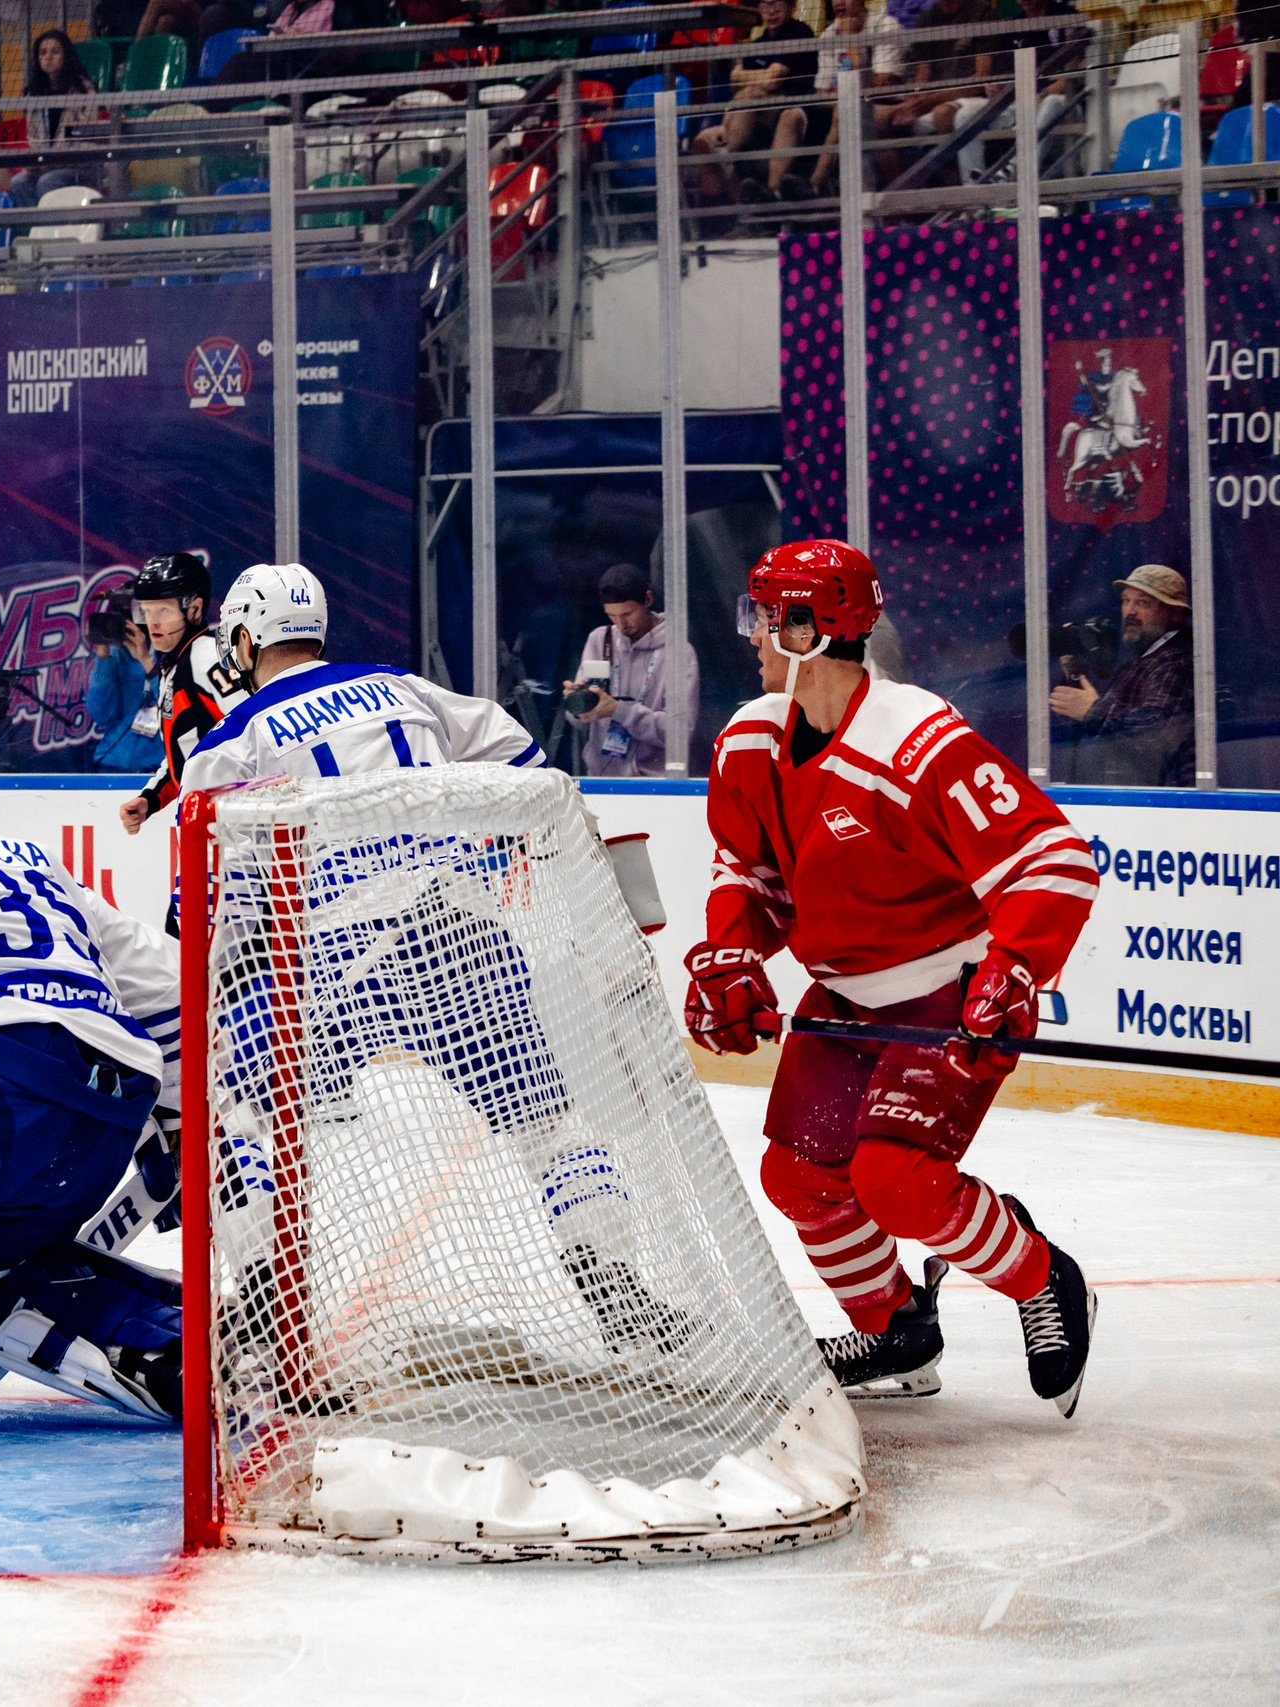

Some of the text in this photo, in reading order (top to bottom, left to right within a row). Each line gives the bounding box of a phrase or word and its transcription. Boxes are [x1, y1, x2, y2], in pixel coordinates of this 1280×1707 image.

[7, 338, 148, 382] МОСКОВСКИЙ
[257, 339, 360, 359] Ферация
[296, 366, 340, 380] ккея
[7, 381, 73, 414] СПОРТ
[296, 391, 344, 406] сквы
[228, 606, 242, 614] CCM
[291, 588, 311, 605] 44
[266, 681, 404, 748] АДАМЧУК
[947, 762, 1020, 832] 13
[1087, 835, 1280, 897] Федерация
[1125, 926, 1242, 965] хоккея
[691, 948, 764, 972] CCM
[1117, 988, 1251, 1044] Москвы
[868, 1104, 938, 1128] CCM
